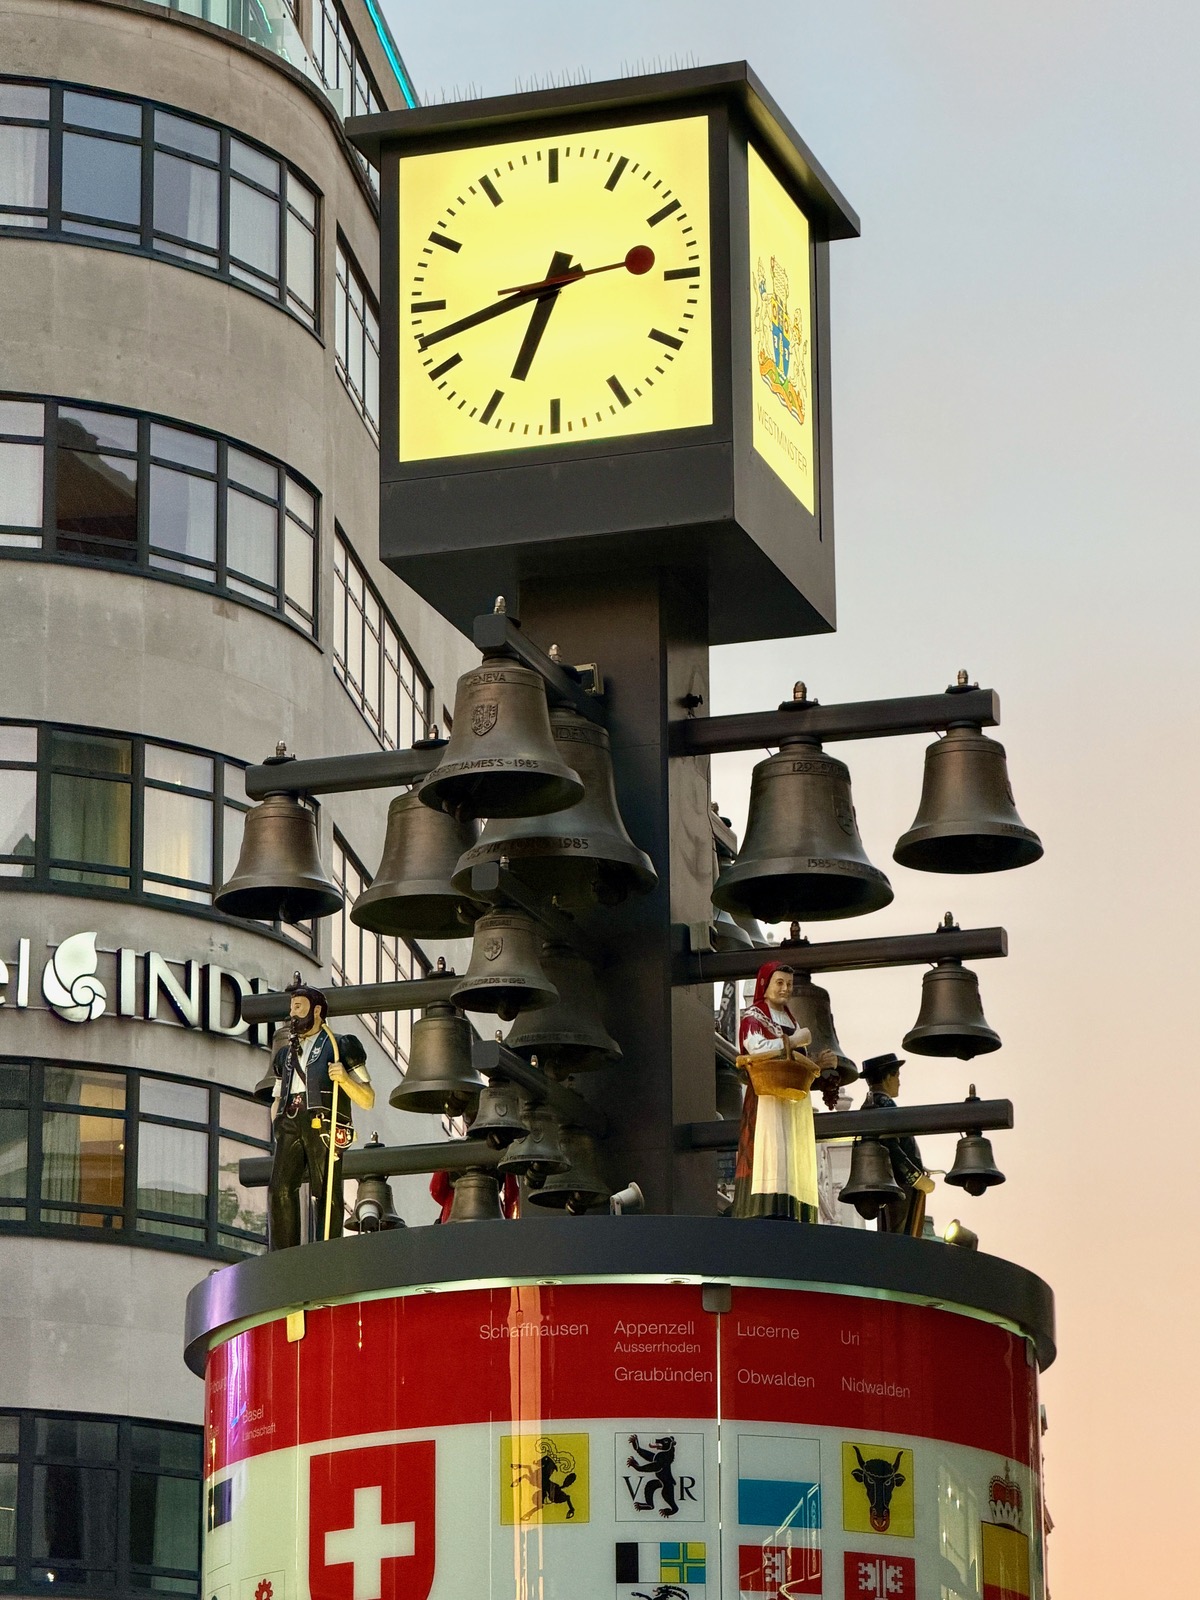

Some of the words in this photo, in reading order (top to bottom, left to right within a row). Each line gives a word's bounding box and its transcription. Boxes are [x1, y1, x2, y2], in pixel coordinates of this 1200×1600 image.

[757, 402, 808, 477] WESTMINSTER
[561, 837, 589, 850] 1985
[117, 947, 284, 1048] INDI
[479, 1322, 589, 1340] Schaffhausen
[614, 1320, 695, 1337] Appenzell
[737, 1321, 800, 1340] Lucerne
[840, 1330, 860, 1346] Uri
[614, 1341, 701, 1354] Ausserrhoden
[614, 1366, 713, 1383] Graubünden
[737, 1368, 815, 1388] Obwalden
[841, 1376, 911, 1399] Nidwalden
[242, 1404, 264, 1425] Basel
